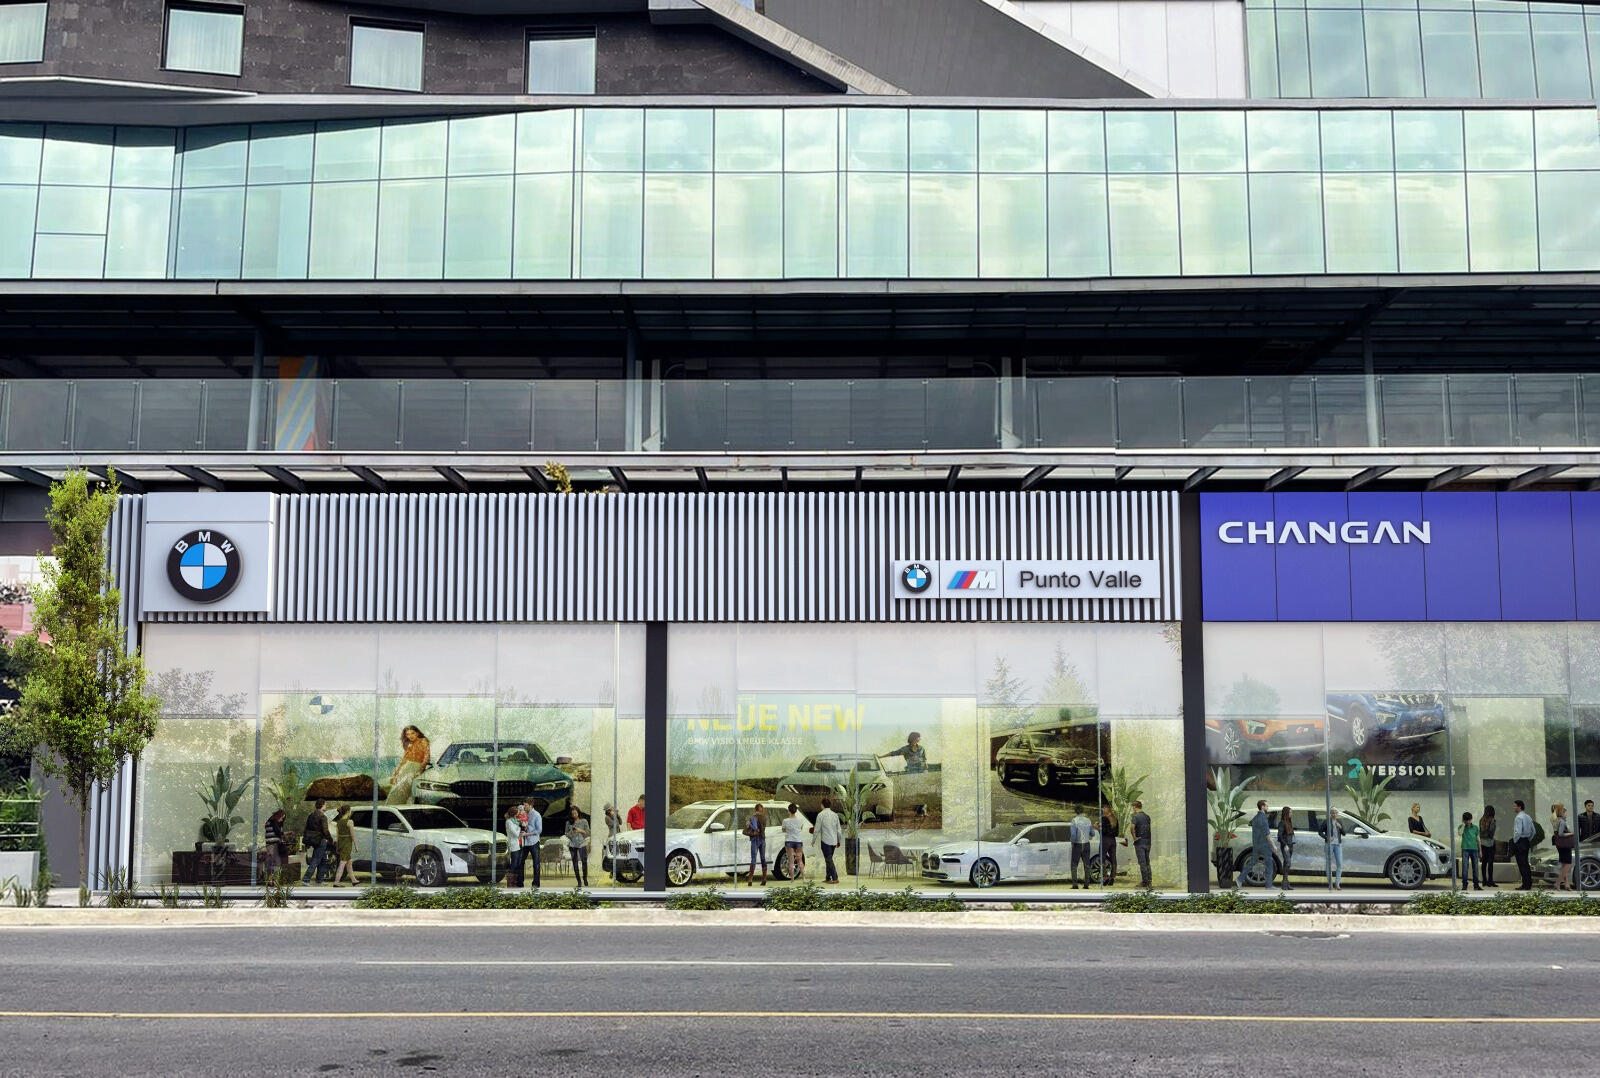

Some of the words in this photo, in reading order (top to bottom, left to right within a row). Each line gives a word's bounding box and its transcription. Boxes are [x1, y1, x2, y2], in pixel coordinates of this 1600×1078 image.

[175, 531, 234, 554] BMW
[1218, 520, 1431, 544] CHANGAN
[904, 564, 929, 574] BMW
[1020, 570, 1080, 588] Punto
[1088, 570, 1142, 588] Valle
[967, 570, 997, 590] M
[788, 704, 865, 731] NEW
[1347, 758, 1362, 779] 2
